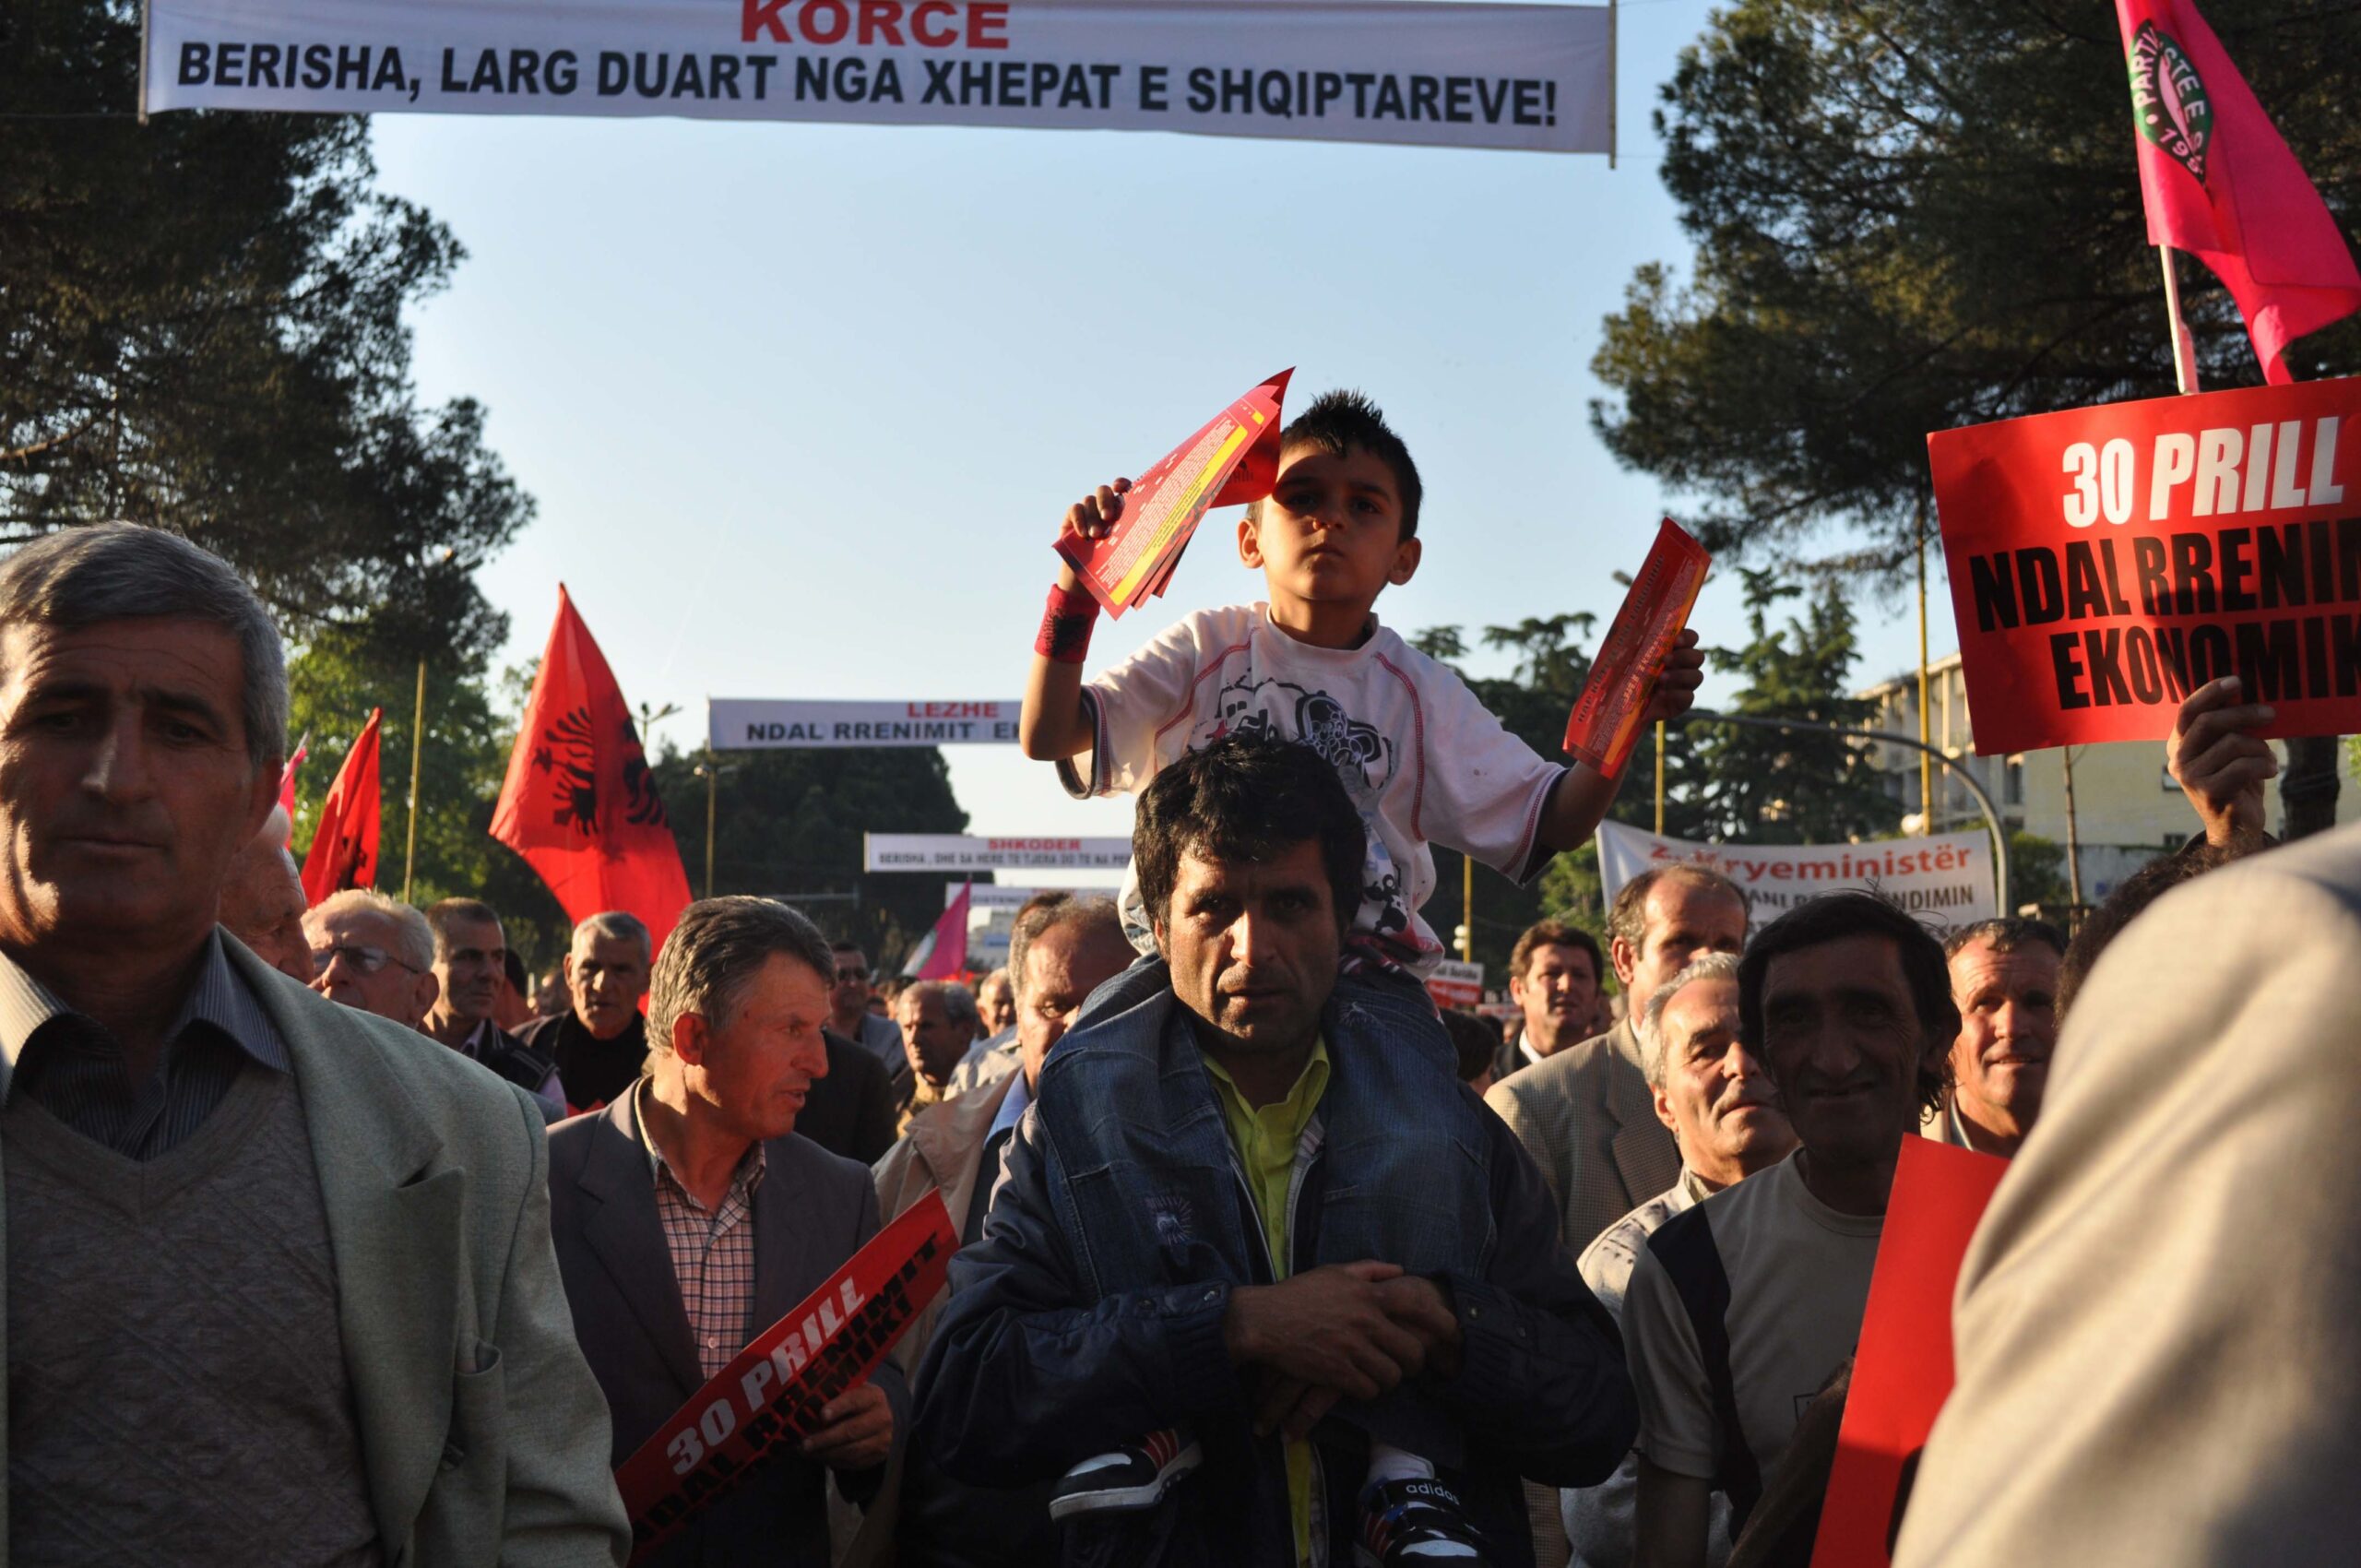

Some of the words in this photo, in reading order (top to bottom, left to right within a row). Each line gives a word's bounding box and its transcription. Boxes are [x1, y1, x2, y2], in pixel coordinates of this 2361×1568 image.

[742, 0, 1009, 49] KORCE
[177, 42, 421, 102] BERISHA,
[440, 47, 578, 96] LARG
[597, 51, 778, 101] DUART
[794, 55, 905, 103] NGA
[920, 59, 1122, 110] XHEPAT
[1138, 65, 1169, 112] E
[1186, 66, 1559, 127] SHQIPTAREVE!
[2061, 436, 2138, 529] 30
[2148, 415, 2344, 522] PRILL
[1968, 538, 2131, 633] NDAL
[746, 721, 825, 742] NDAL
[833, 721, 975, 741] RRENIMIT
[907, 701, 999, 719] LEZHE
[988, 837, 1081, 851] SHKODER
[1892, 884, 1974, 910] NDIMIN
[741, 1230, 938, 1452] RRENIMIT
[666, 1397, 737, 1475] 30
[740, 1275, 865, 1413] PRILL
[1405, 1481, 1461, 1506] adidas
